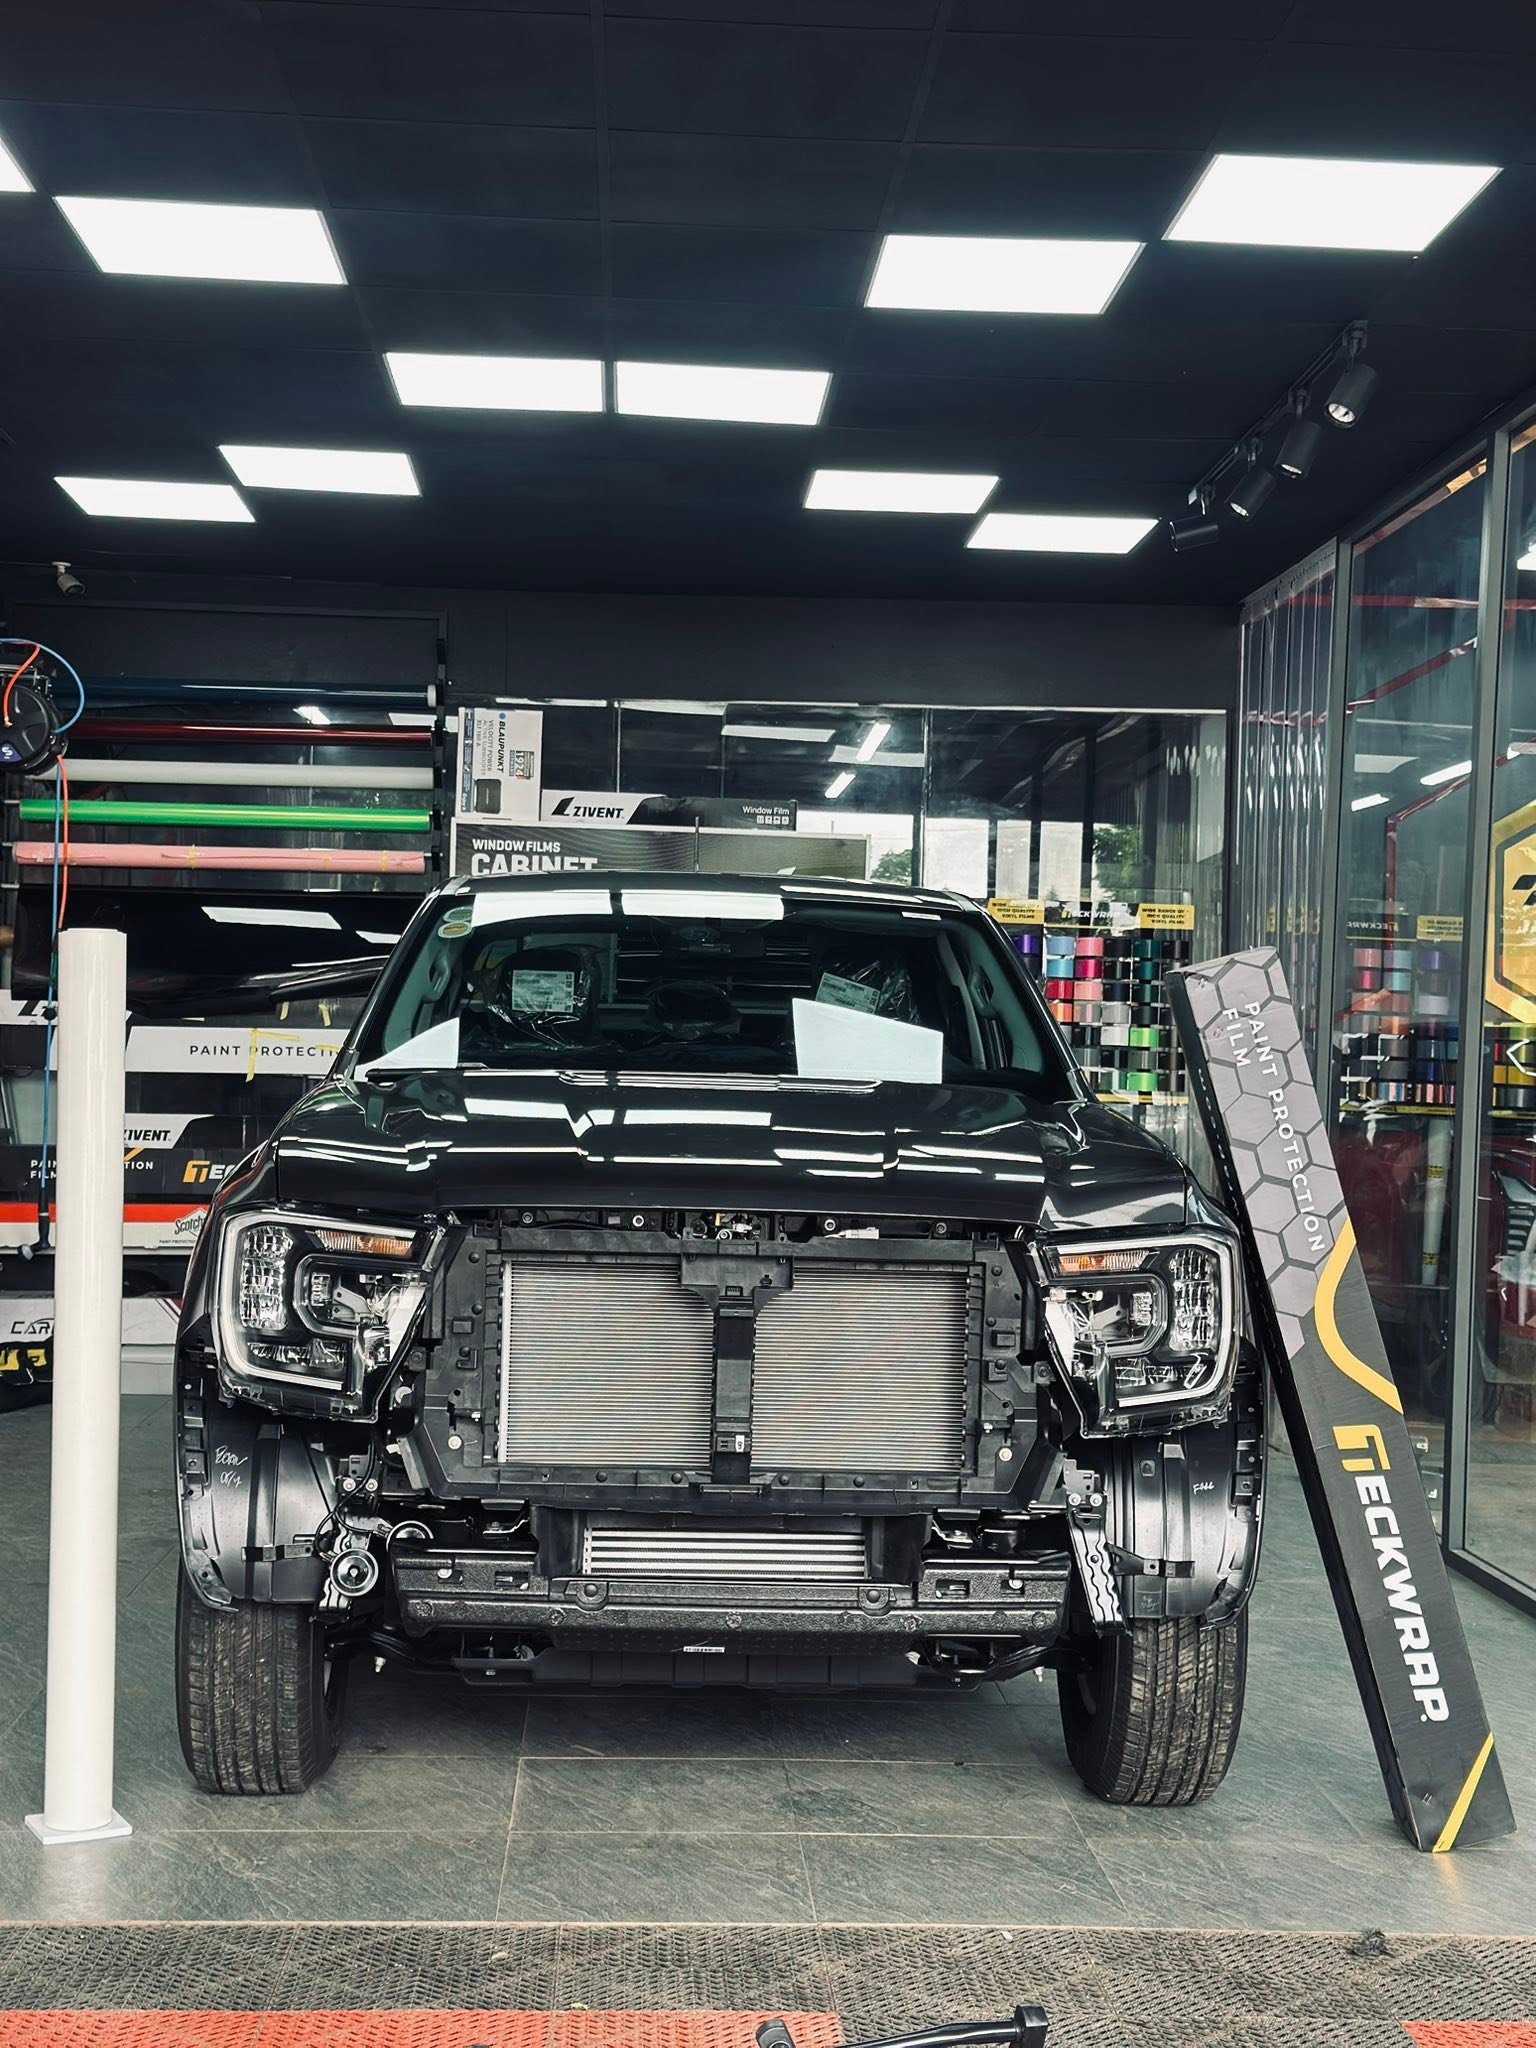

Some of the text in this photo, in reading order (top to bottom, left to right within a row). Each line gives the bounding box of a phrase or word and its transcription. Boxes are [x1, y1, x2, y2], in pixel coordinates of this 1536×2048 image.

[497, 721, 506, 773] BLAUPUNKT
[572, 806, 624, 819] ZIVENT
[742, 805, 790, 815] Window Film
[472, 838, 561, 853] WINDOW FILMS
[471, 852, 598, 877] CABINET
[1222, 1007, 1251, 1067] FILM
[190, 1045, 241, 1056] PAINT
[1245, 1001, 1326, 1252] PAINT PROTECTION
[124, 1129, 171, 1141] IVENT
[11, 1320, 54, 1335] CAR
